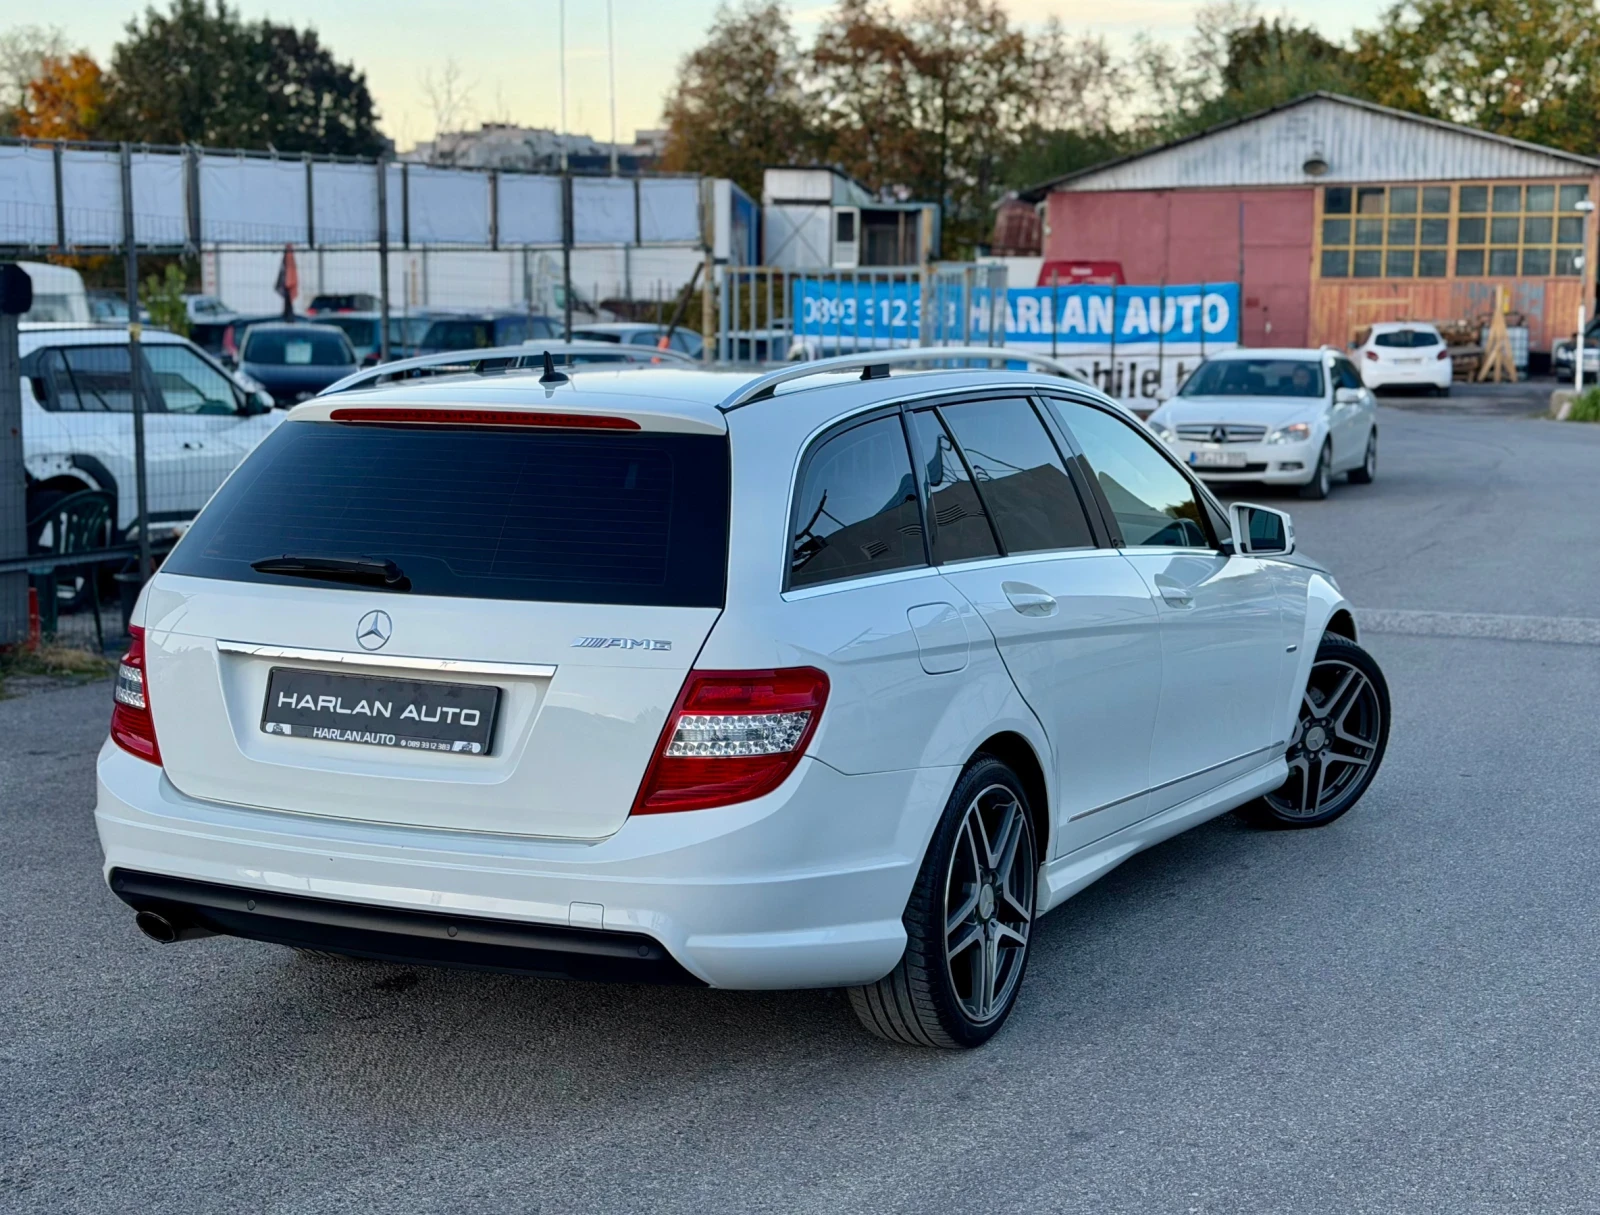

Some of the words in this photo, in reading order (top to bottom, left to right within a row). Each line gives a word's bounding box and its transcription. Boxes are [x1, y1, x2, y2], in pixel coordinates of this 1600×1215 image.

[1121, 293, 1230, 334] AUTO
[603, 637, 672, 651] AMG
[277, 691, 393, 718] HARLAN
[399, 703, 481, 727] AUTO
[313, 727, 396, 746] HARLAN.AUTO
